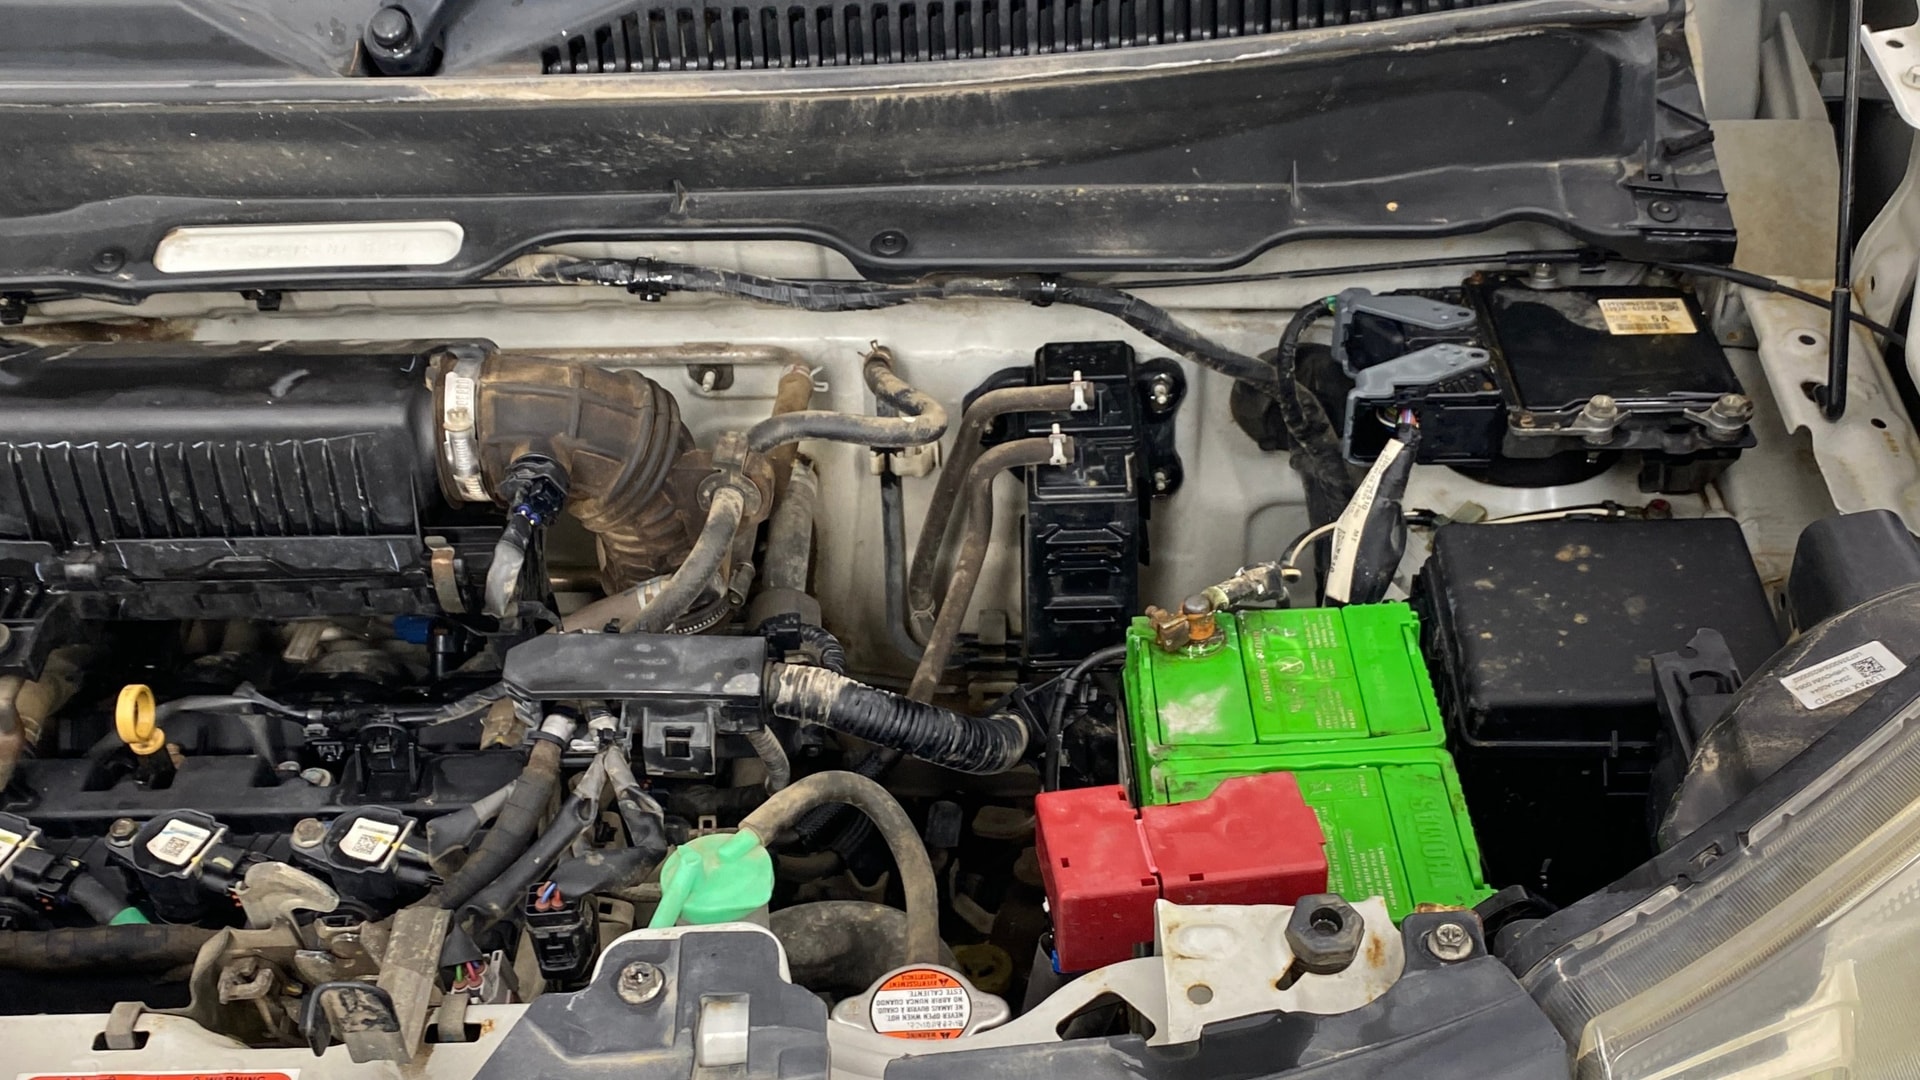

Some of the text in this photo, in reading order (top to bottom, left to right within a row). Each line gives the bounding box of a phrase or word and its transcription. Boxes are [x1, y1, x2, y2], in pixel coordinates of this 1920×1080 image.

[1854, 674, 1885, 690] LUMAX
[1411, 797, 1457, 888] THOMAS
[942, 1011, 963, 1019] NEVER
